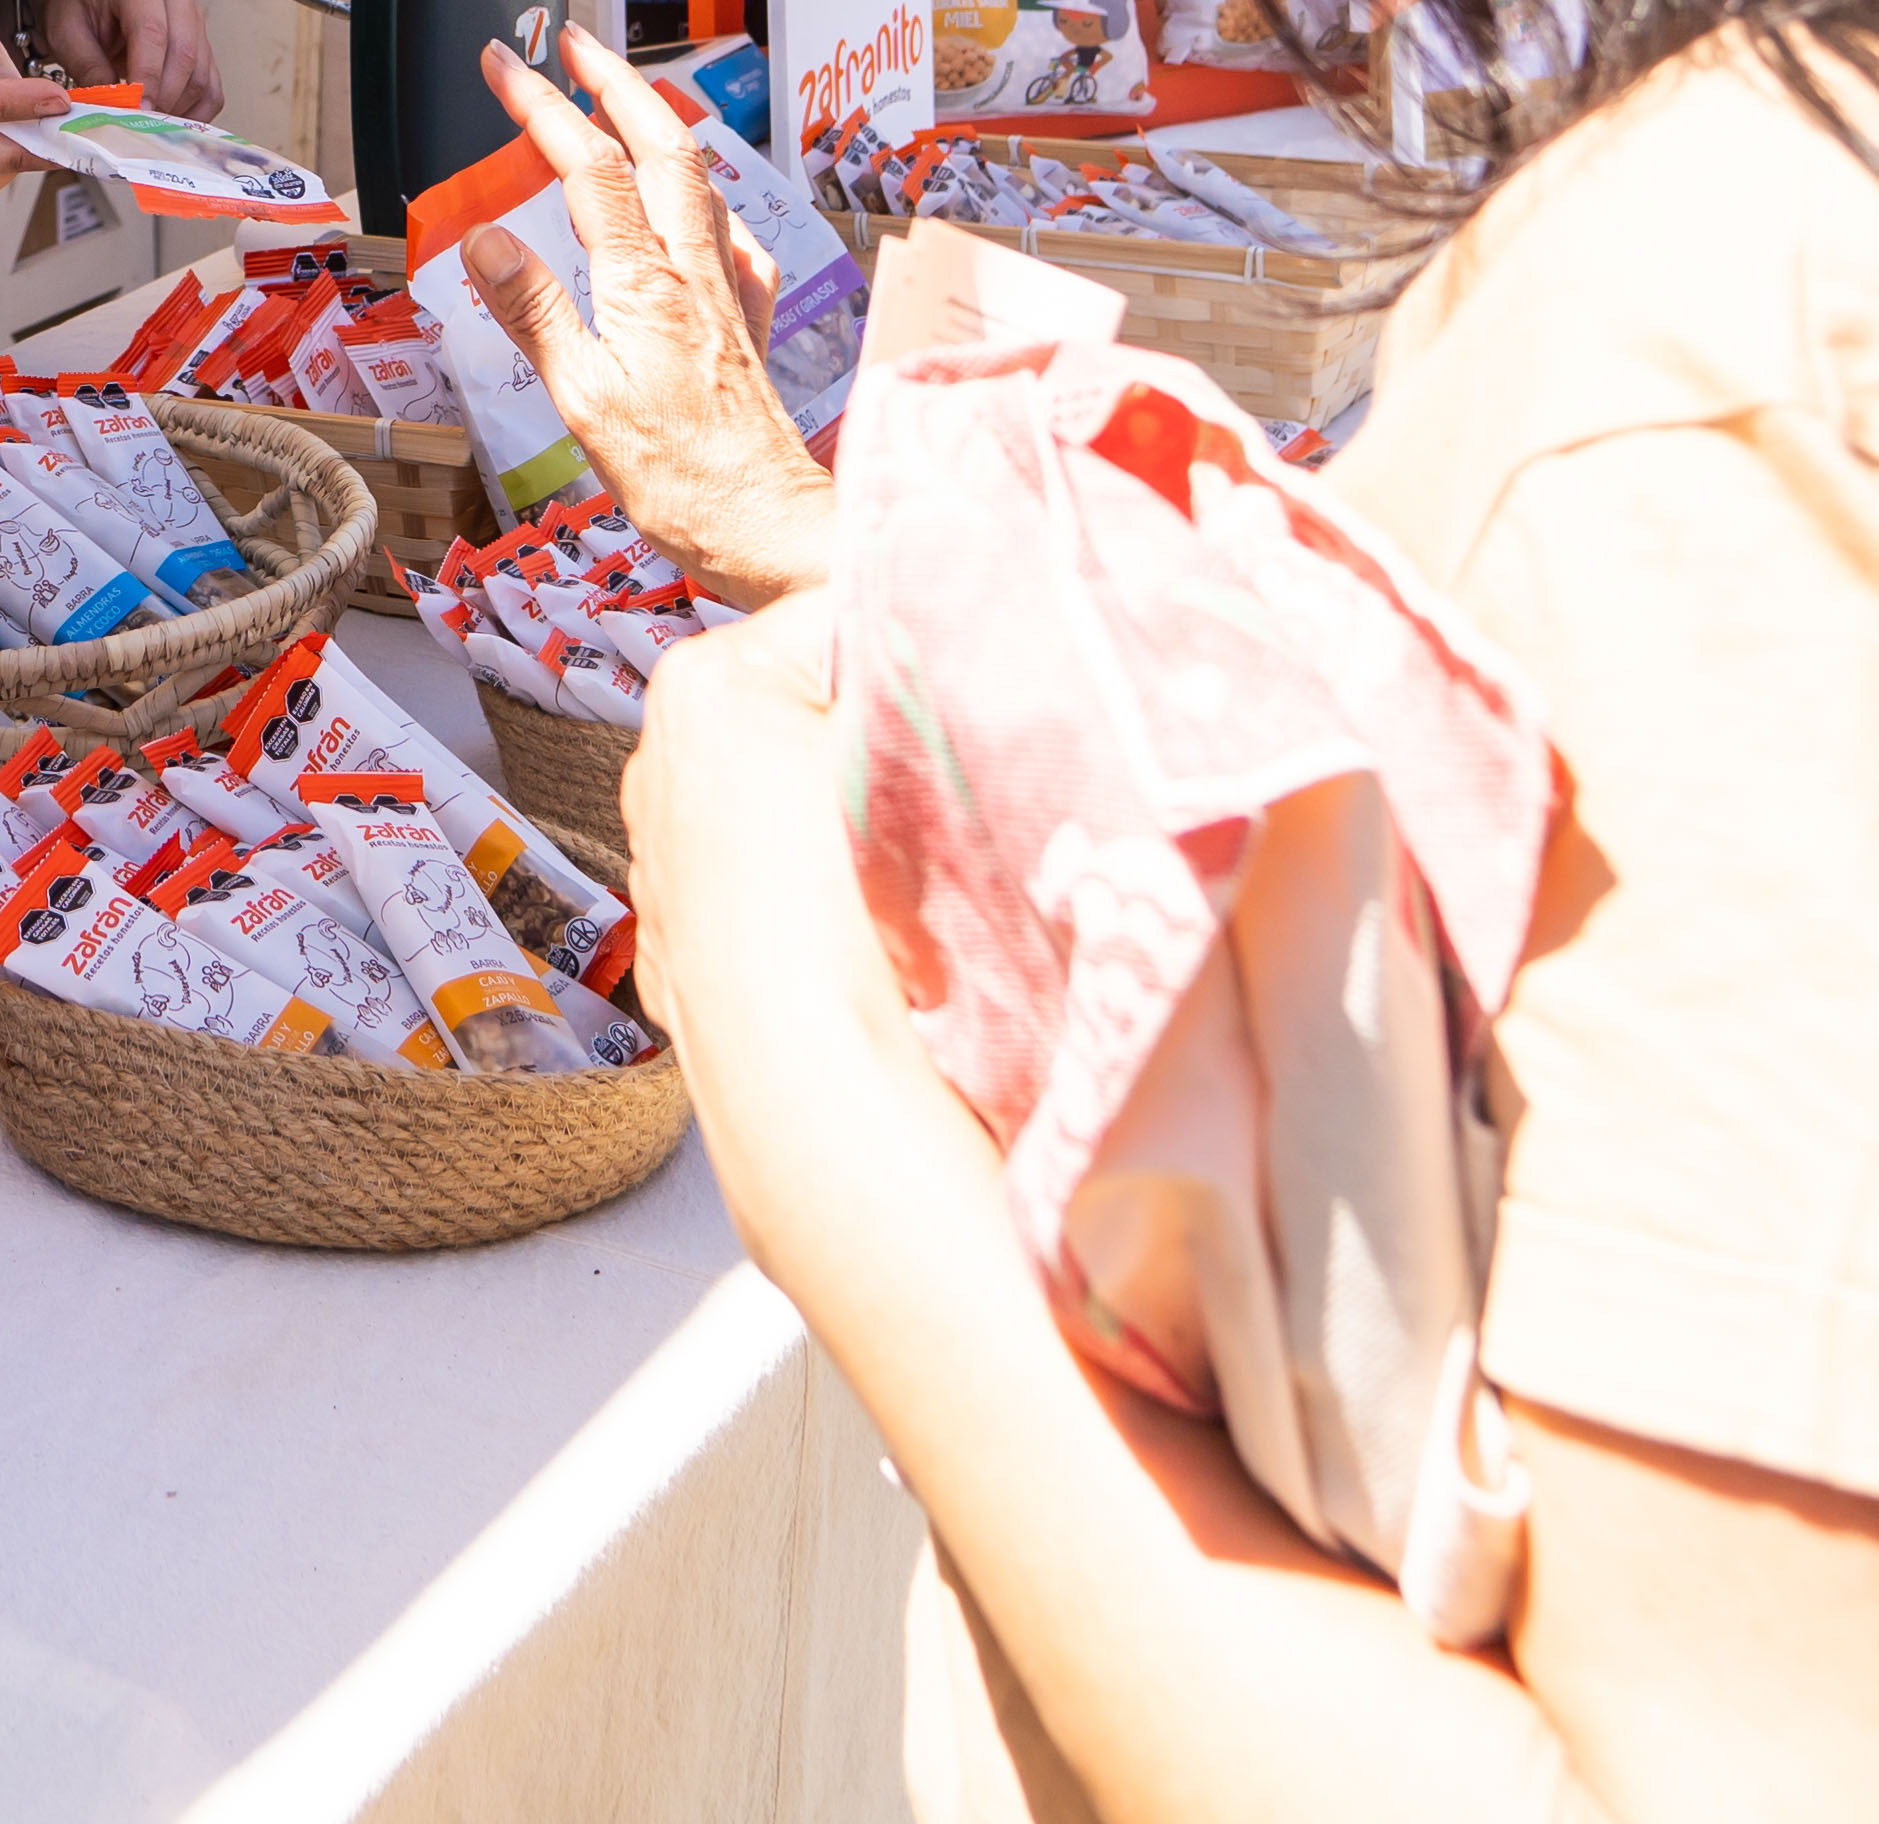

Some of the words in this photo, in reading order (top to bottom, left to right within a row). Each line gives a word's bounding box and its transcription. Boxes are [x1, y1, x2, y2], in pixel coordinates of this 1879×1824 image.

[944, 12, 984, 29] MIEL
[94, 414, 154, 436] zafrán
[65, 586, 96, 613] BARRA
[66, 586, 122, 639] ALMENDRAS
[93, 605, 122, 632] COCO
[329, 728, 361, 772] honestas
[356, 821, 442, 843] zafrán
[369, 840, 407, 850] Recetas
[407, 840, 449, 852] honestas
[230, 887, 295, 936] zafrán
[251, 920, 278, 943] Recetas
[277, 900, 308, 923] honestas
[61, 895, 133, 976] zafrán
[84, 942, 114, 982] Recetas
[113, 905, 146, 944] honestas
[469, 958, 506, 970] BARRA
[482, 992, 532, 1008] ZAPALLO
